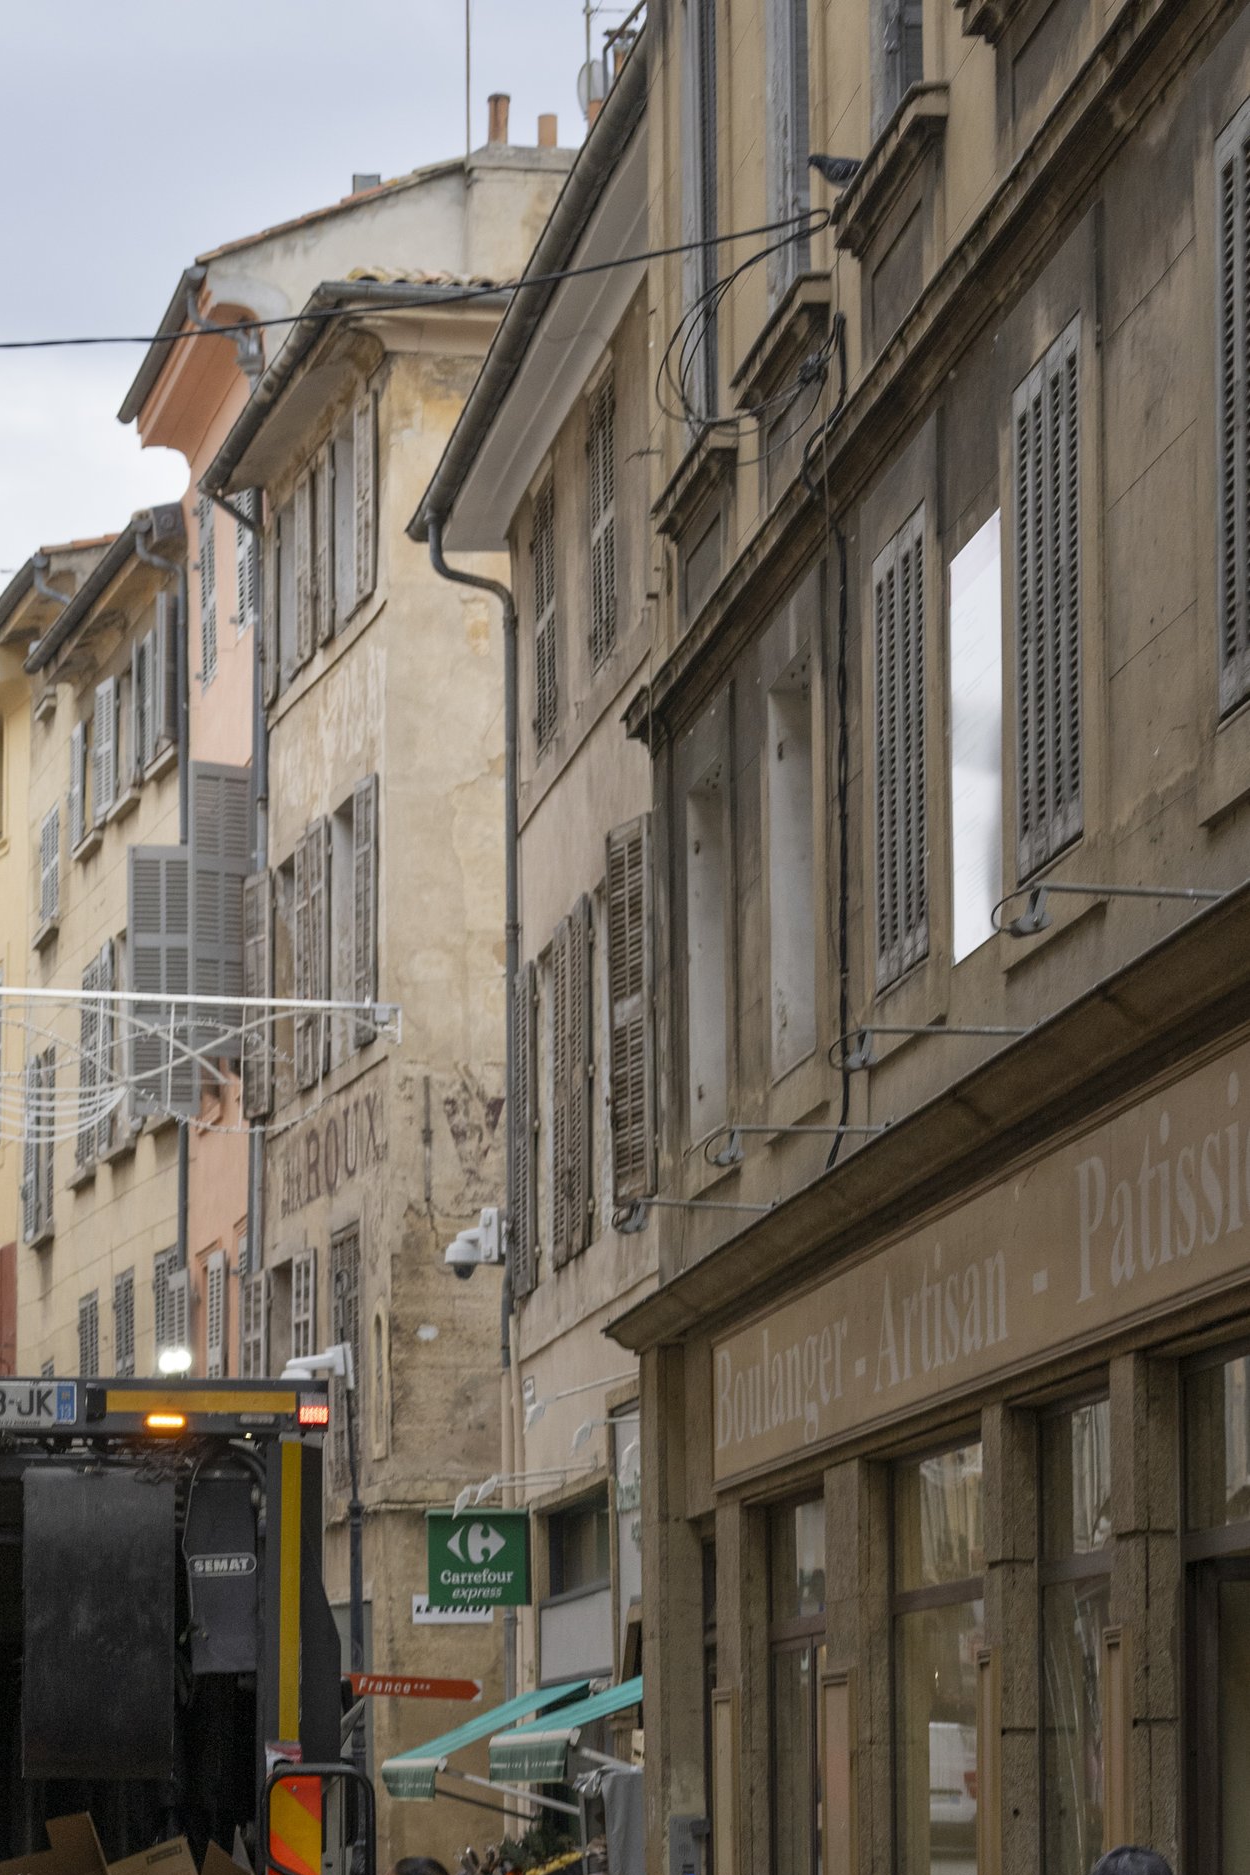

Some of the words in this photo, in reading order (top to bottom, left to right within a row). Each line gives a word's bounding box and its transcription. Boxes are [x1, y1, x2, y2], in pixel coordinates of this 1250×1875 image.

[306, 1090, 377, 1203] ROUX
[715, 1314, 848, 1448] Boulanger
[873, 1241, 1009, 1391] Artisan
[1075, 1071, 1250, 1304] Patissi
[194, 1557, 249, 1573] SEMAT
[440, 1568, 513, 1585] Carrefour
[451, 1586, 503, 1604] express
[358, 1677, 412, 1694] France
